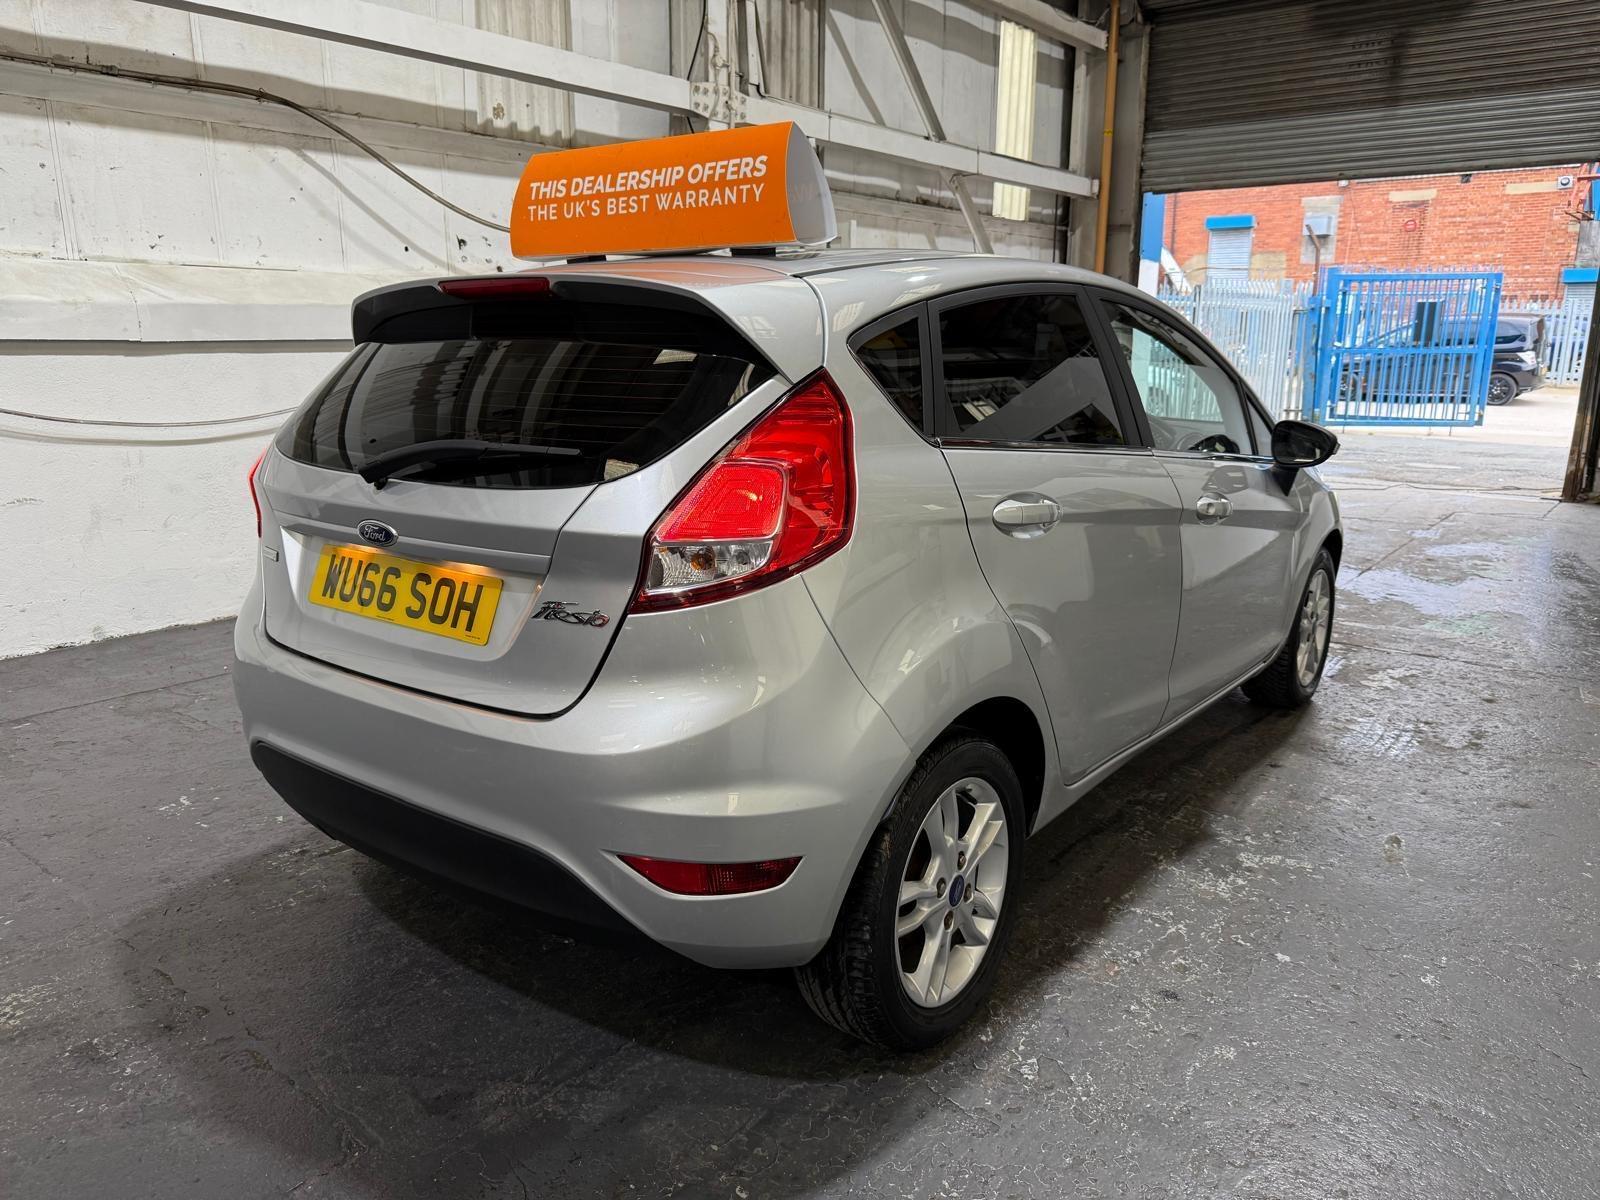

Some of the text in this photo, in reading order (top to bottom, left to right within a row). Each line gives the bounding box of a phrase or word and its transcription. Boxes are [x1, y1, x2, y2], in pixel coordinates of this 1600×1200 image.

[530, 155, 768, 200] THIS DEALERSHIP OFFERS
[528, 183, 765, 222] THE UK'S BEST WARRANTY
[364, 524, 386, 541] Ford
[322, 553, 484, 632] WU66 SOH
